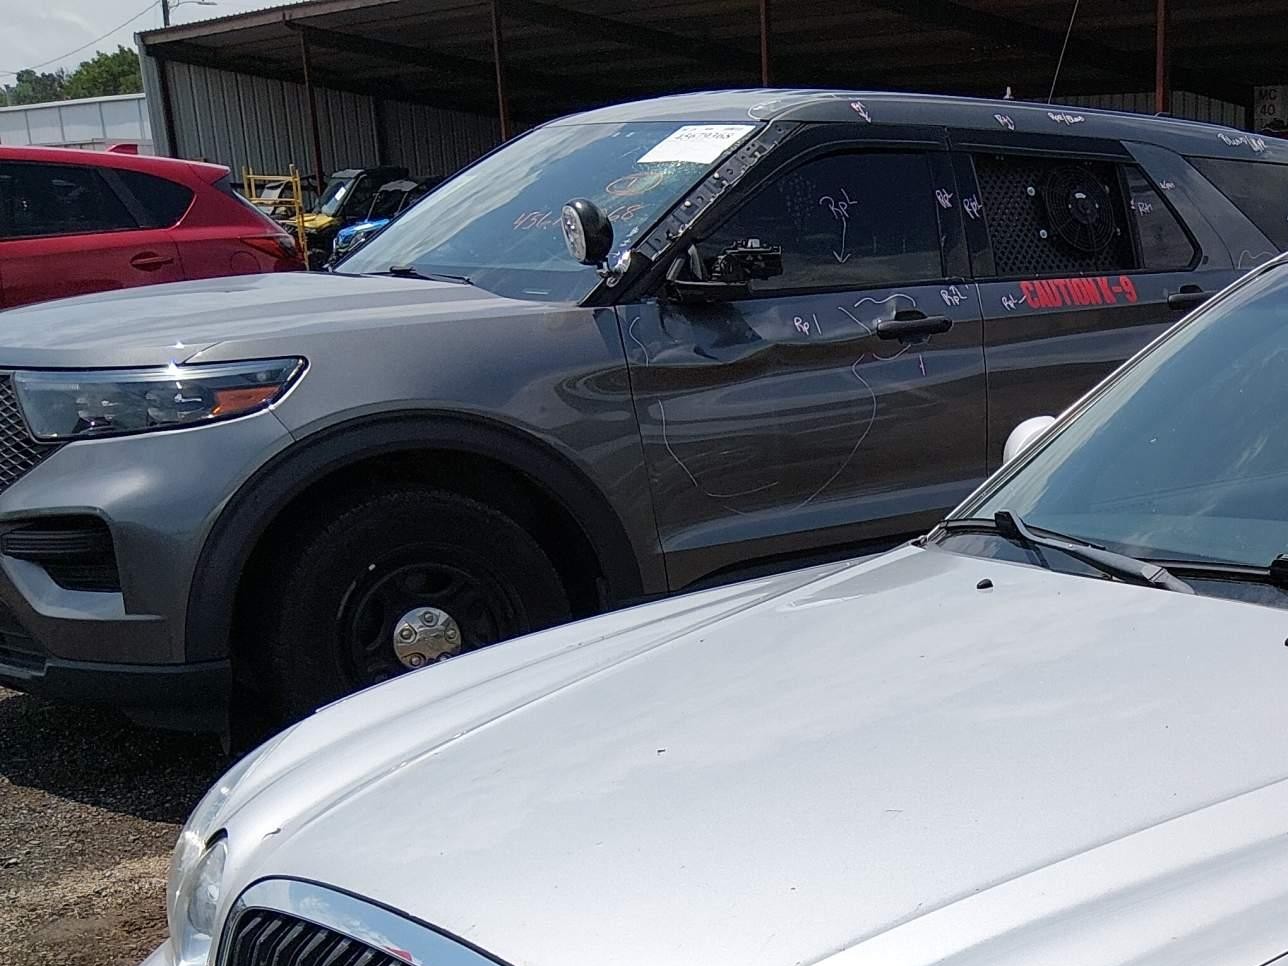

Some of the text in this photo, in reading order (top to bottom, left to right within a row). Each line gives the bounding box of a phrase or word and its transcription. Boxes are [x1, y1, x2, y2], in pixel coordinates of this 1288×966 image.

[1259, 89, 1278, 100] MC
[1260, 103, 1276, 116] 40
[1019, 276, 1137, 308] CAUTION K-9
